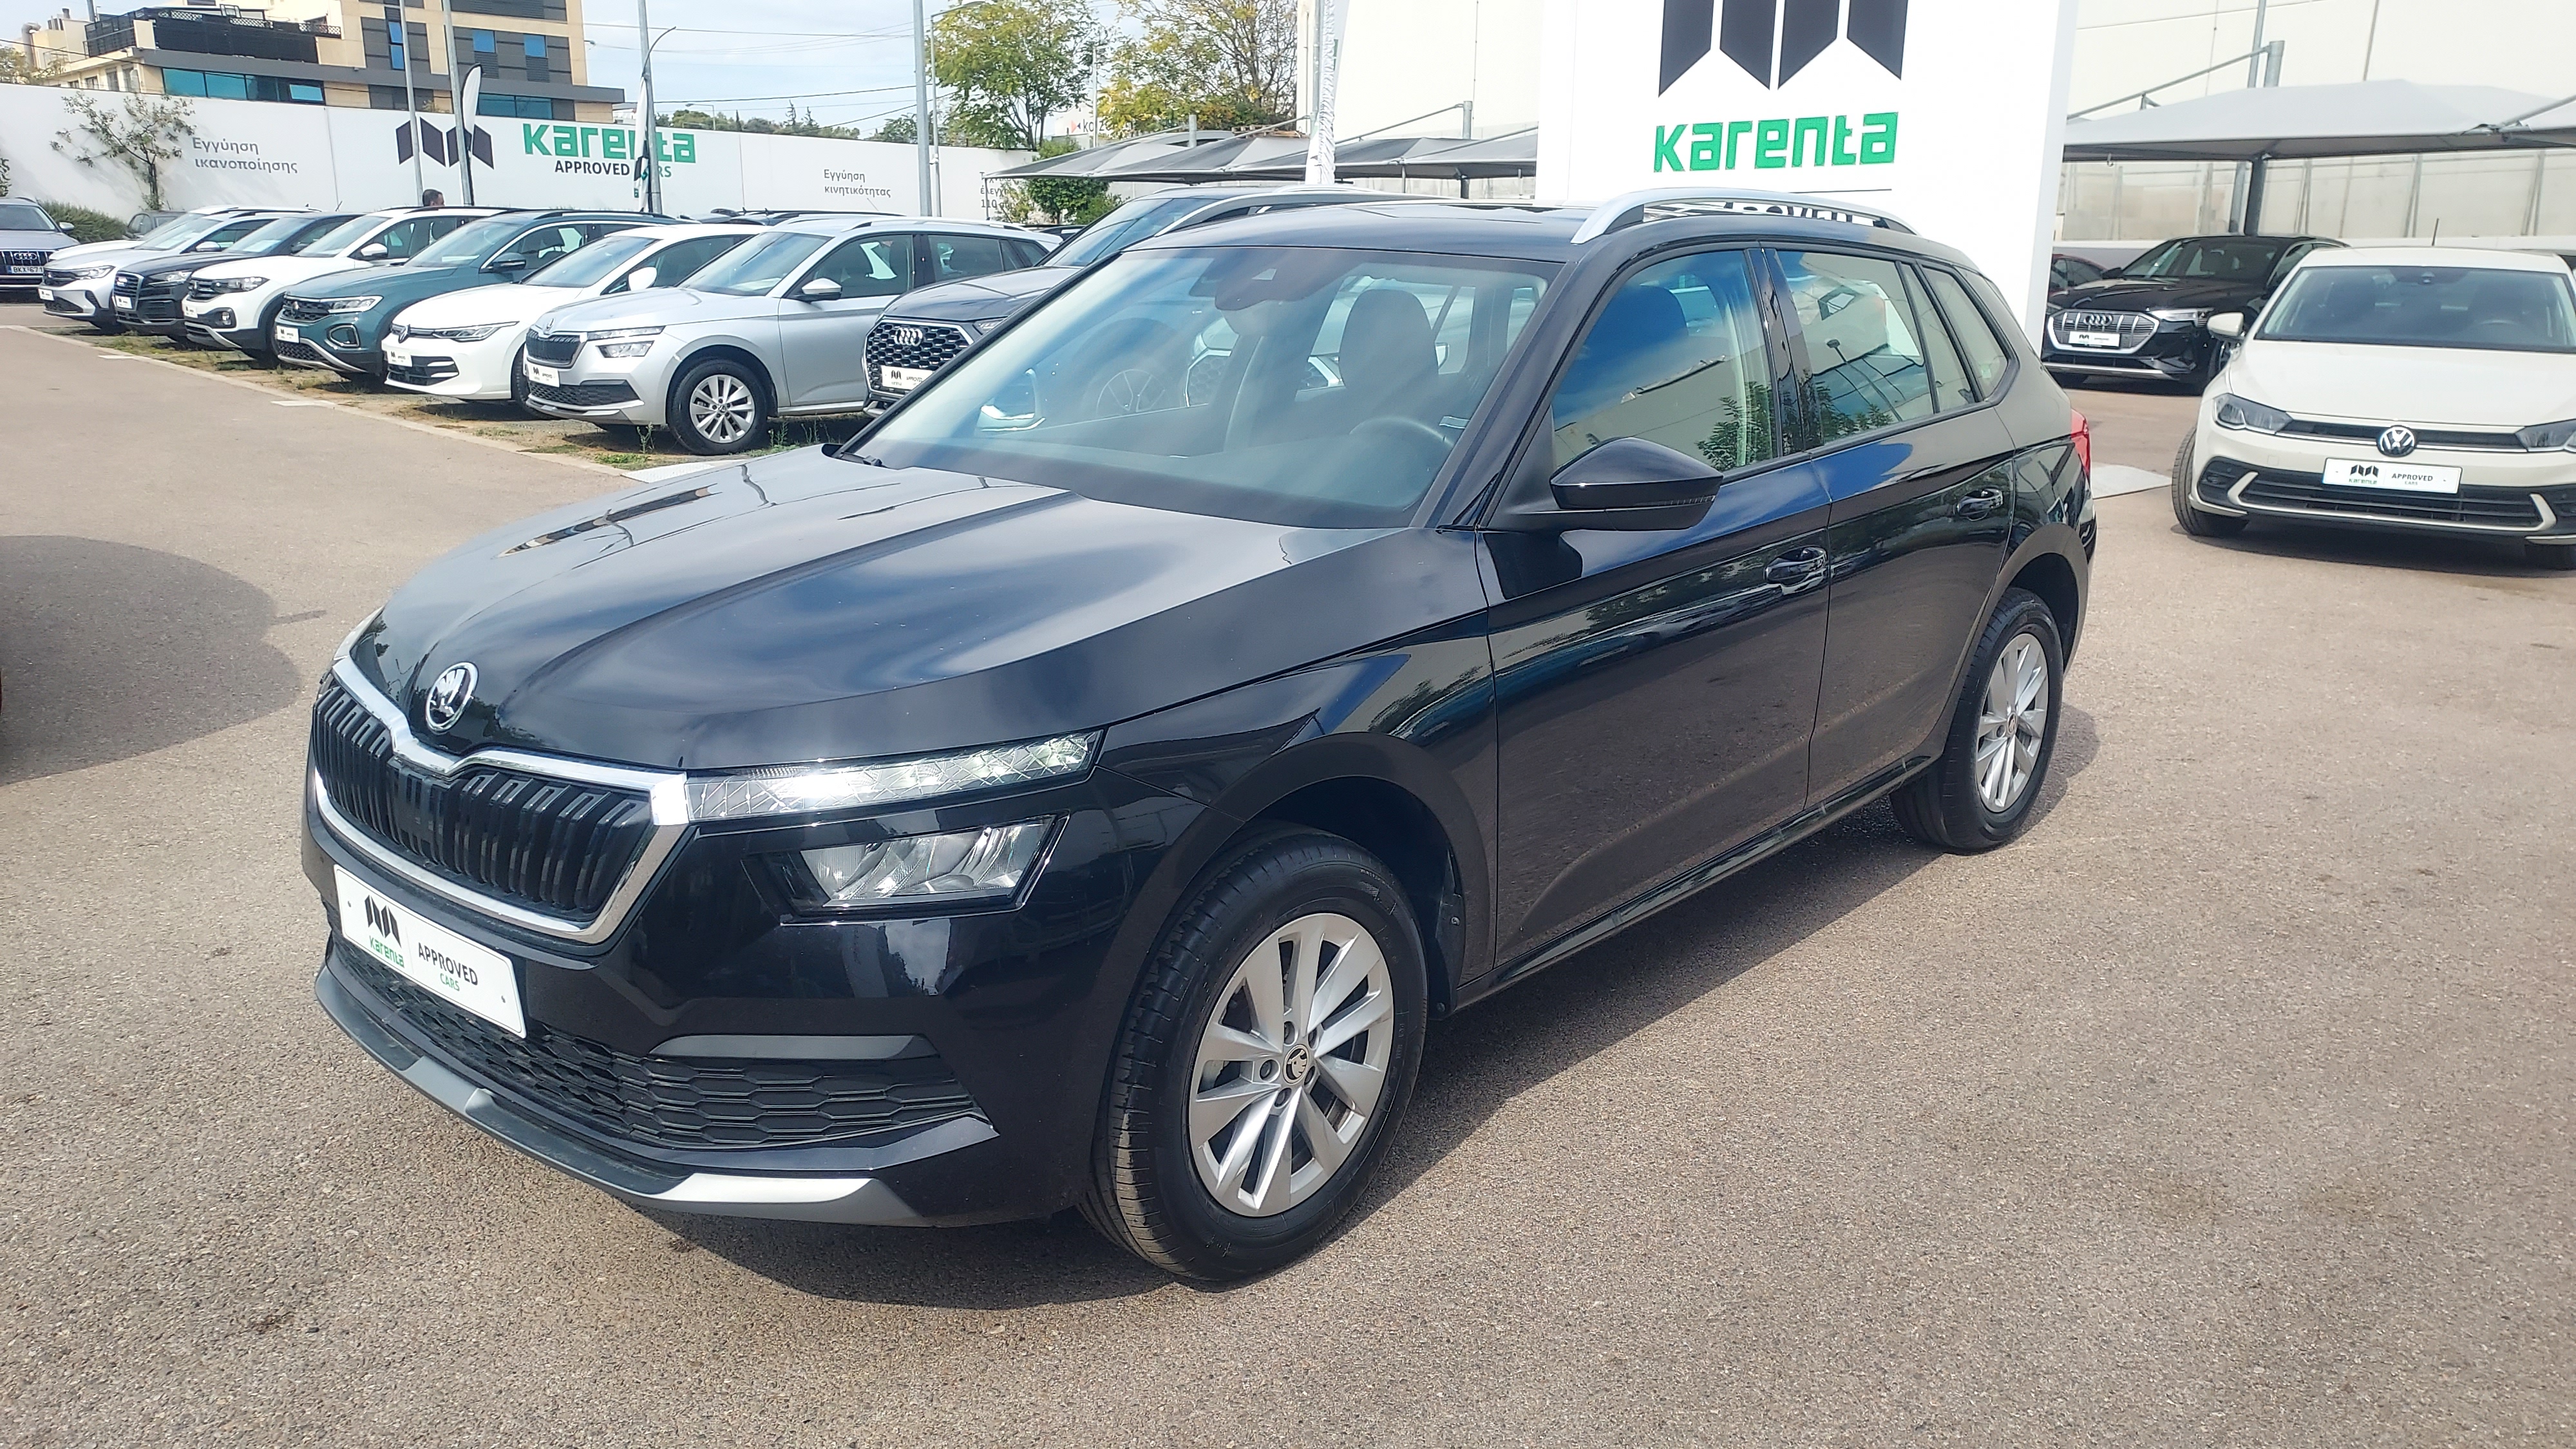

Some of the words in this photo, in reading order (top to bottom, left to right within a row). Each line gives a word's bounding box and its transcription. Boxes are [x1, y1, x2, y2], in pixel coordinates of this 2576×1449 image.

[193, 137, 259, 155] Εγγύηση
[1654, 111, 1899, 173] karenta
[194, 158, 298, 174] ικανοποίησης
[554, 160, 630, 176] APPROVED
[824, 169, 866, 183] Εγγύηση
[824, 185, 891, 198] κινητικότητας
[981, 199, 998, 208] 110
[2391, 473, 2434, 482] APPROVED
[368, 934, 406, 969] karenta
[417, 942, 478, 987] APPROVED
[440, 972, 460, 992] CARS
